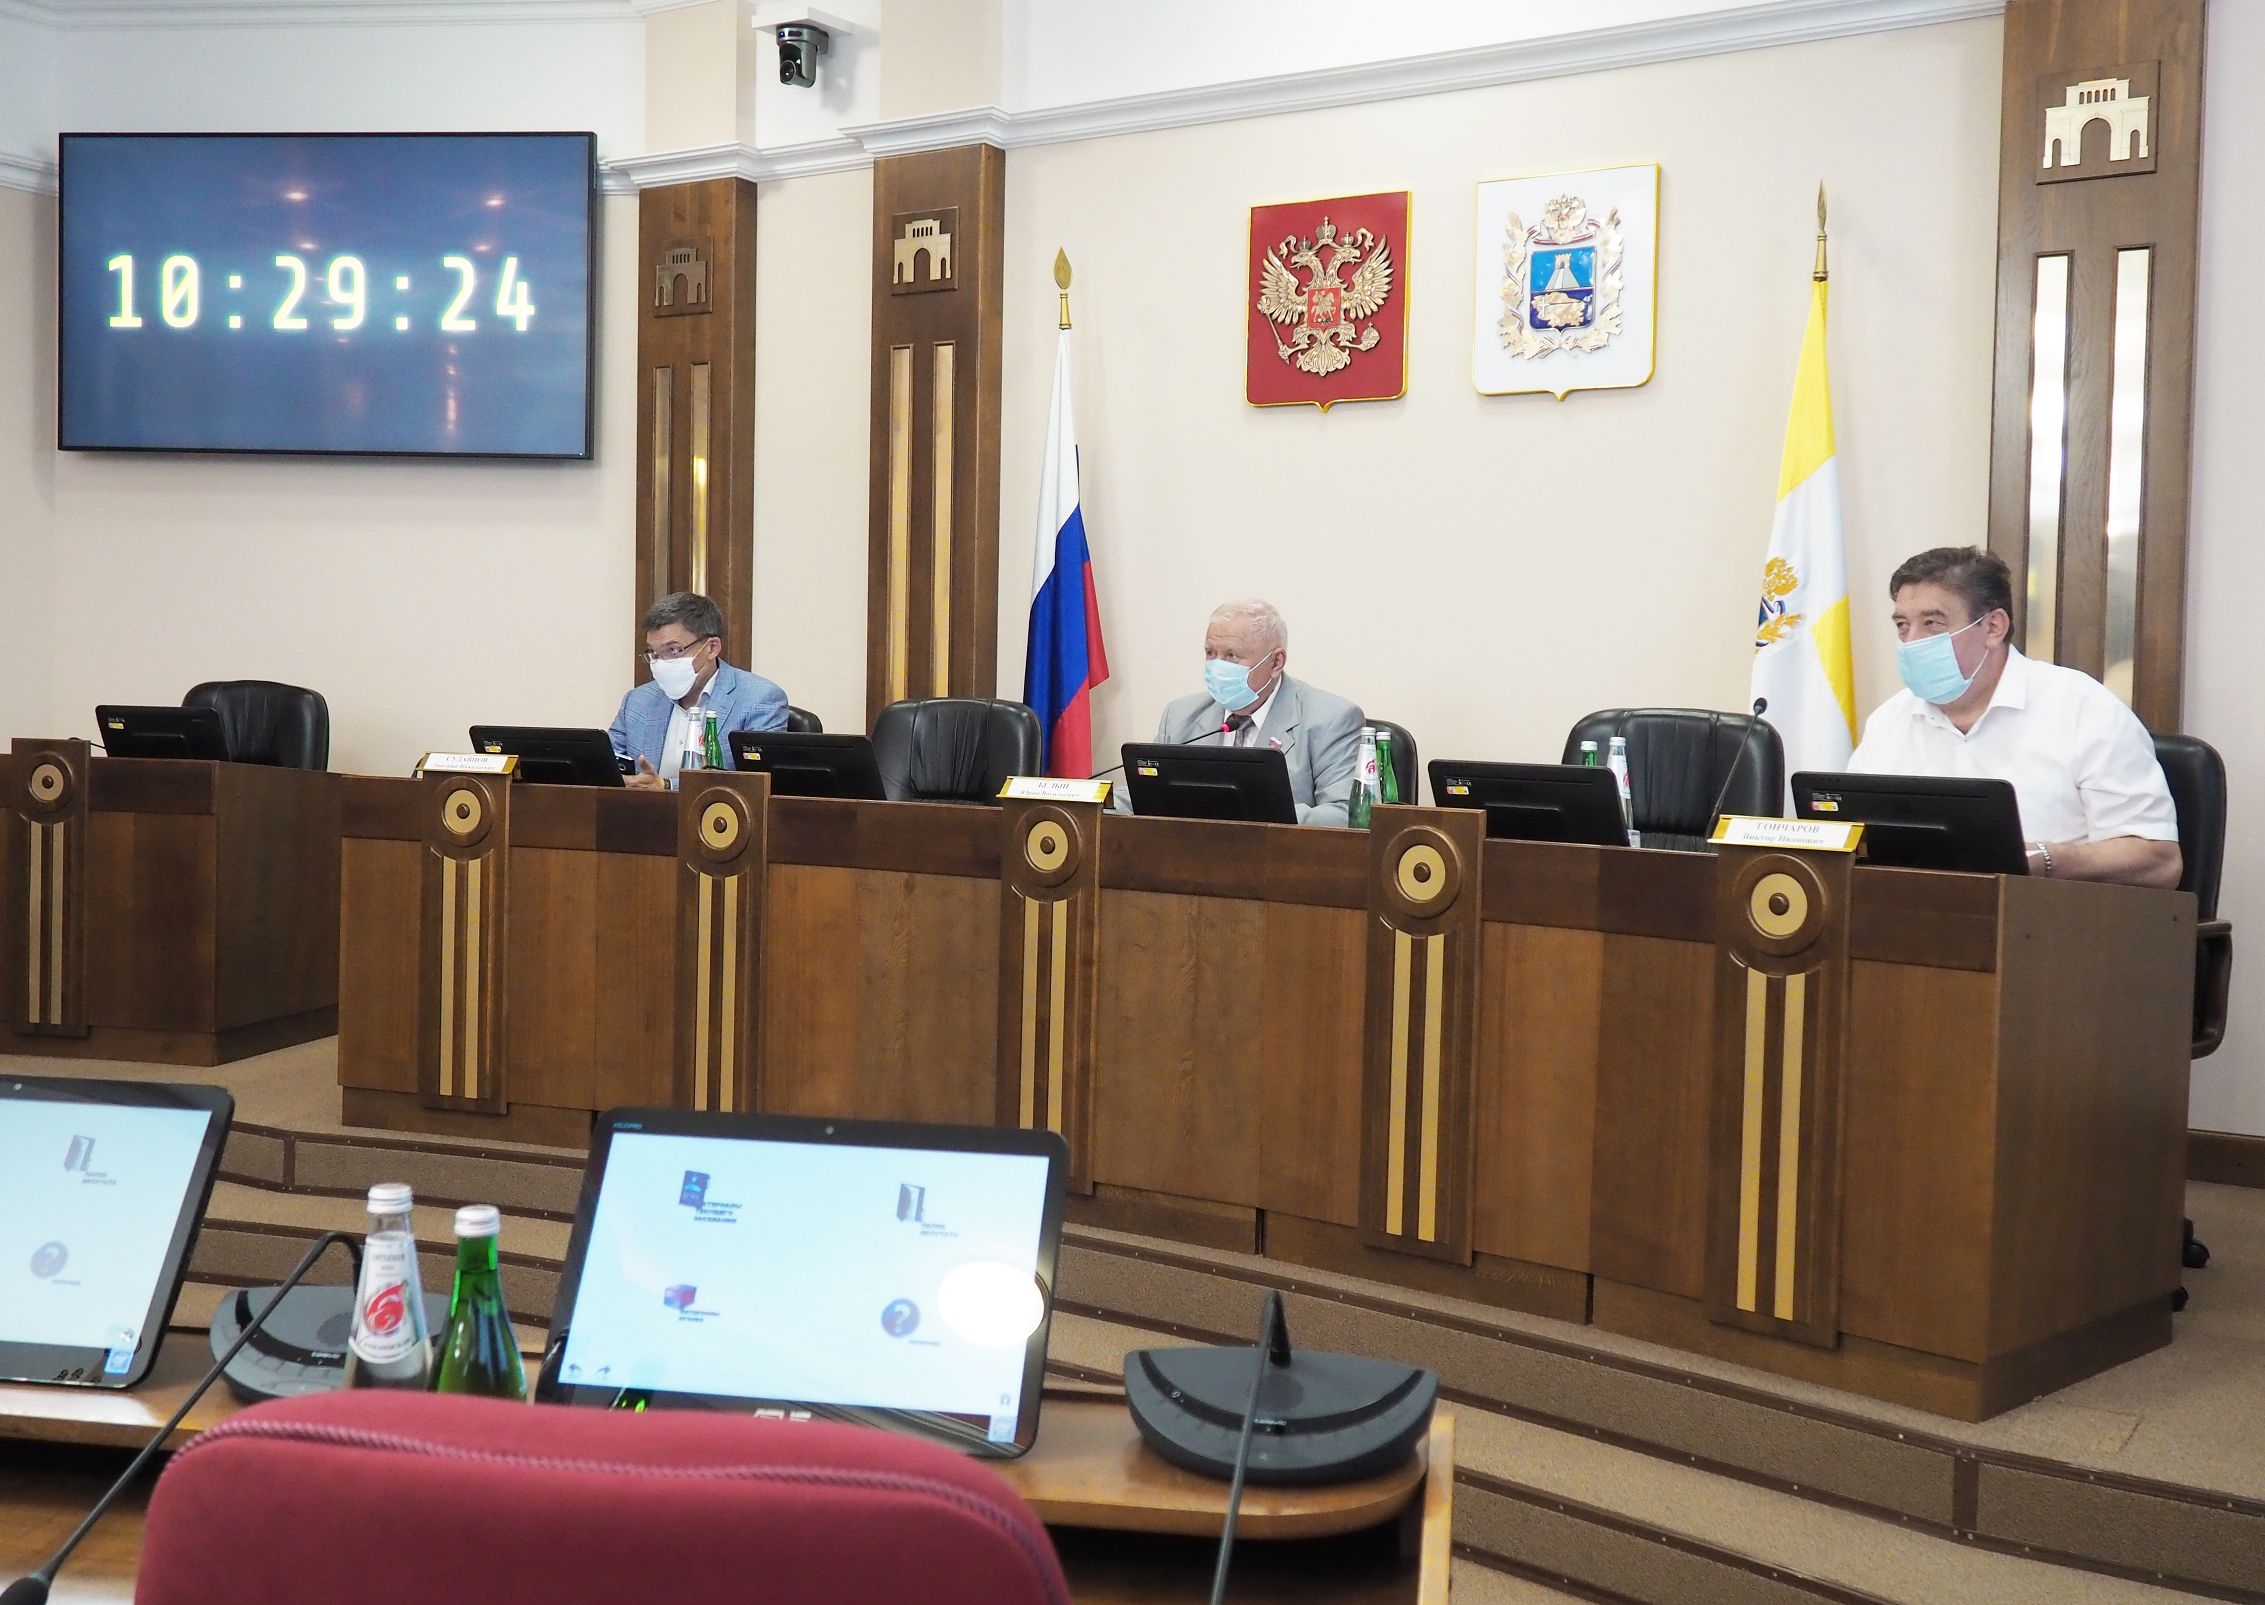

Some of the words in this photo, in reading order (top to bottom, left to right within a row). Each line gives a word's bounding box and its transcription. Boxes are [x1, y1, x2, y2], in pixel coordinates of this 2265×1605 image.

[108, 254, 535, 332] 10:29:24
[1757, 822, 1820, 833] ГОНЧАРОВ
[1743, 832, 1775, 842] Виктор
[1778, 835, 1824, 845] Иванович
